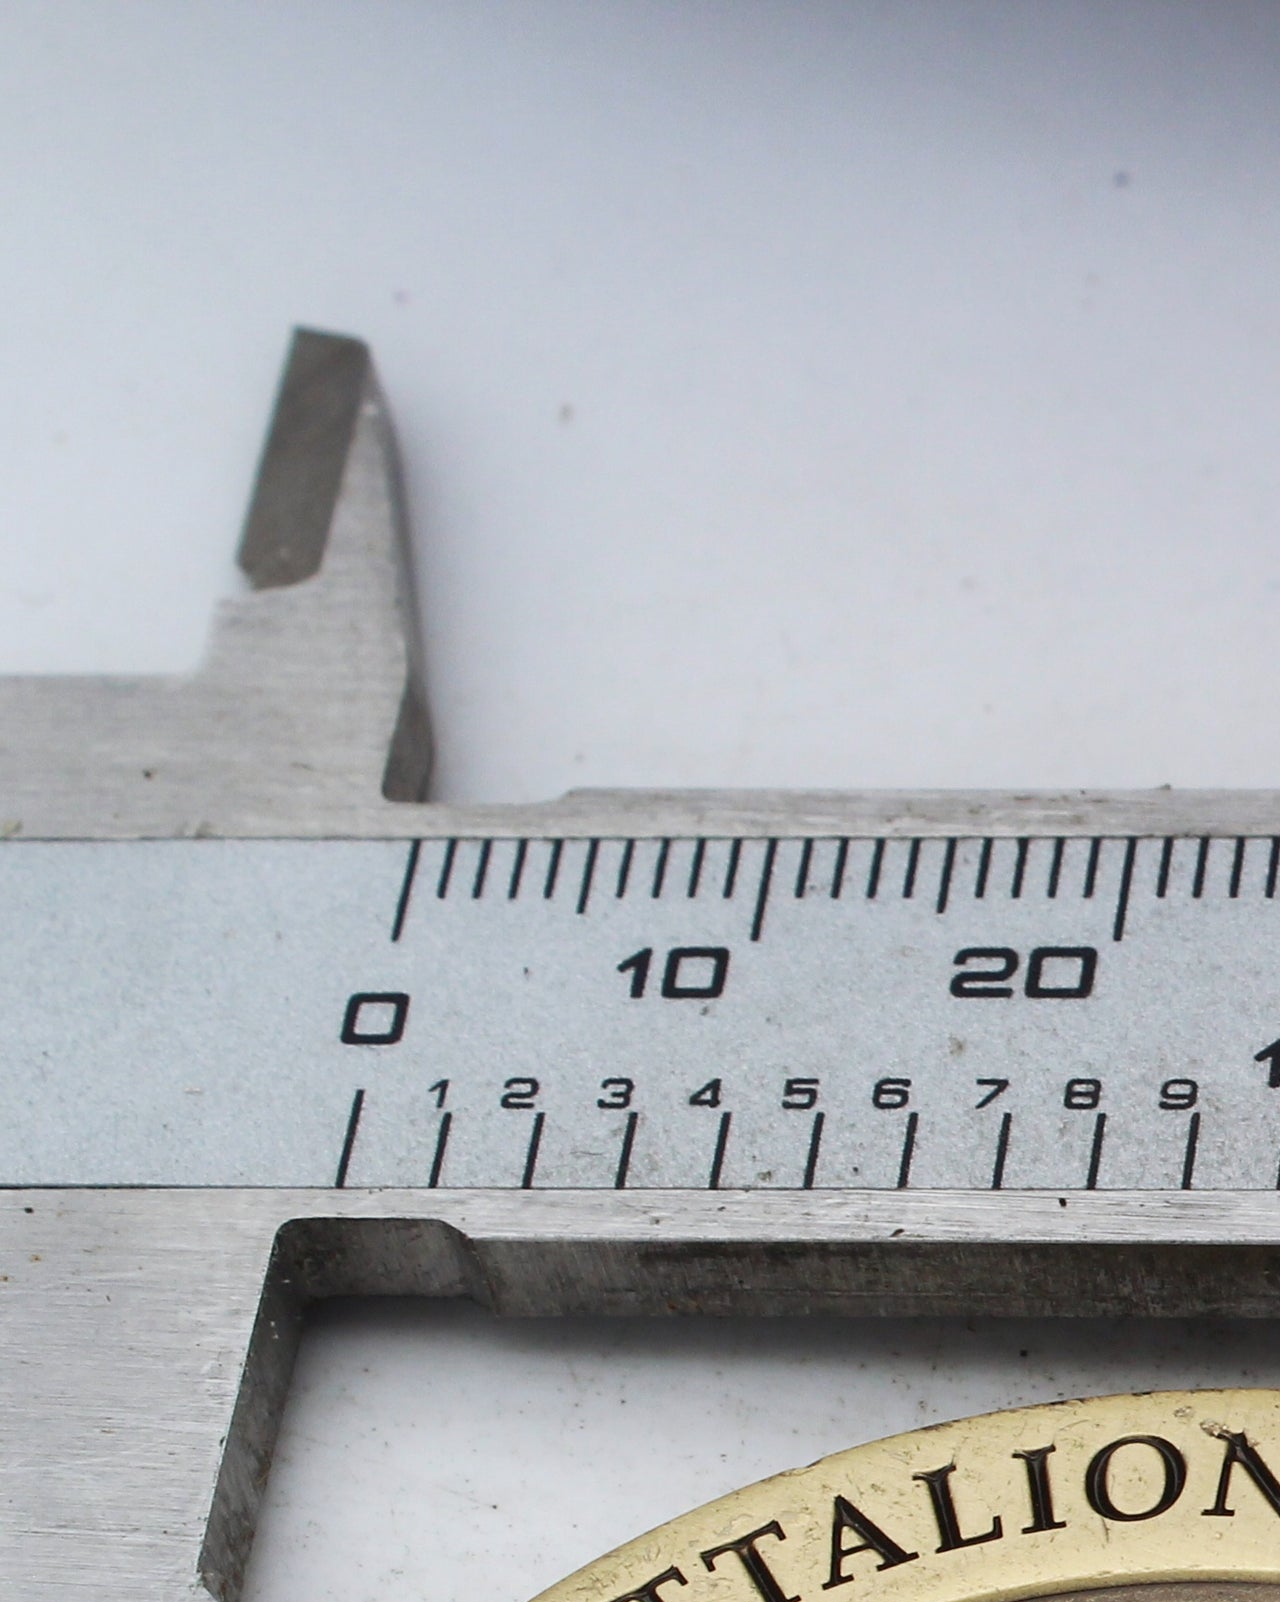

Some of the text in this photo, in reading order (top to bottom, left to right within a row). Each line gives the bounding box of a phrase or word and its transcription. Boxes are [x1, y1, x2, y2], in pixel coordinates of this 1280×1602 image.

[338, 991, 411, 1047] 0
[616, 945, 731, 1001] 10
[948, 944, 1100, 1001] 20
[427, 1078, 451, 1110] 1
[499, 1076, 541, 1111] 2
[595, 1076, 636, 1111] 3
[687, 1077, 723, 1110] 4
[780, 1076, 821, 1111] 5
[870, 1076, 913, 1112] 6
[974, 1077, 1011, 1111] 7
[1062, 1077, 1104, 1112] 8
[1157, 1077, 1200, 1112] 9
